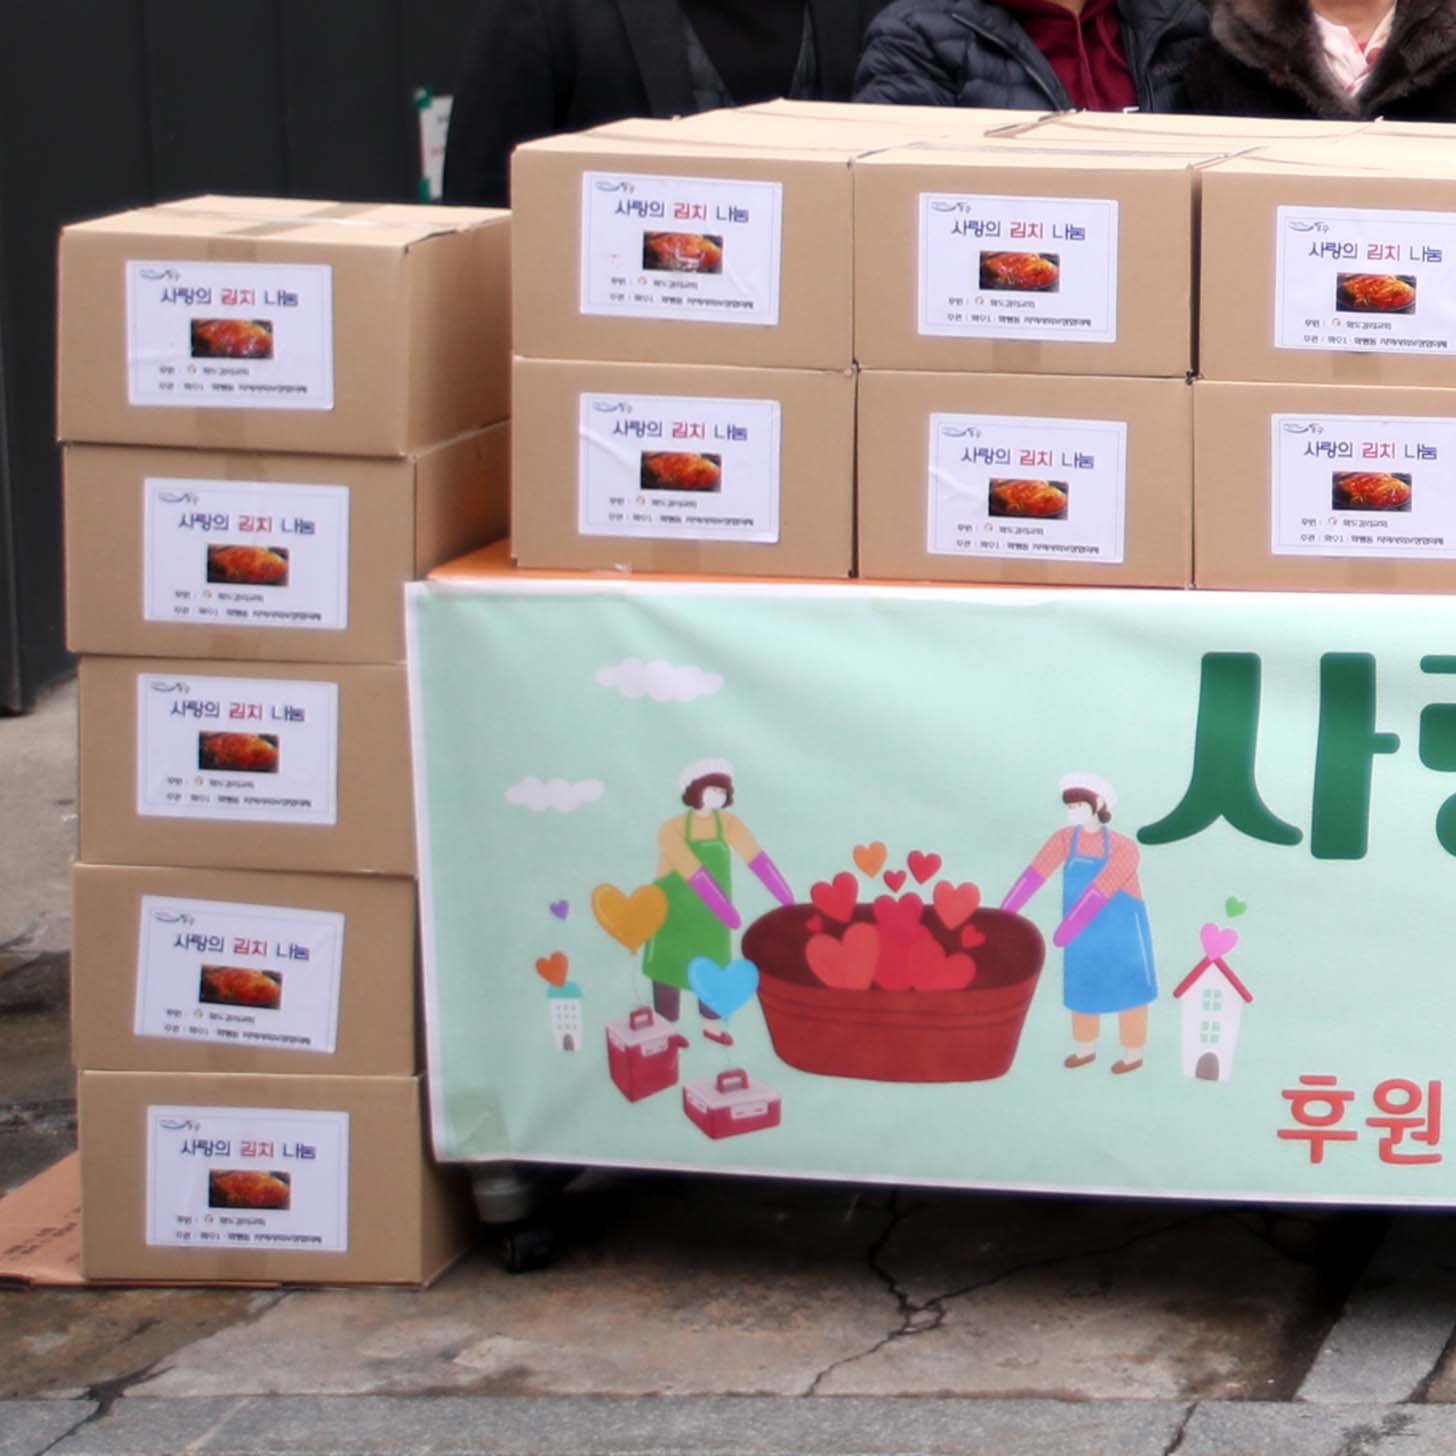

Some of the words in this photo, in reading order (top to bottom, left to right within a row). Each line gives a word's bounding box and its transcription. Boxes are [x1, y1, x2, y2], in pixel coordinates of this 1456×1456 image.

[673, 202, 708, 221] 김치
[951, 219, 1001, 239] 사랑의
[1009, 221, 1044, 240] 김치
[1052, 223, 1086, 241] 나눔
[1308, 241, 1358, 261] 사랑의
[1366, 243, 1401, 262] 김치
[1409, 245, 1443, 263] 나눔
[220, 288, 256, 307] 김치
[671, 421, 706, 440] 김치
[960, 446, 1011, 466] 사랑의
[1019, 449, 1053, 467] 김치
[1061, 451, 1095, 470] 나눔
[1303, 440, 1354, 460] 사랑의
[1361, 441, 1396, 459] 김치
[1404, 442, 1438, 461] 나눔
[238, 515, 273, 533] 김치
[228, 702, 263, 721] 김치
[232, 937, 268, 957] 김치
[239, 1140, 274, 1158] 김치
